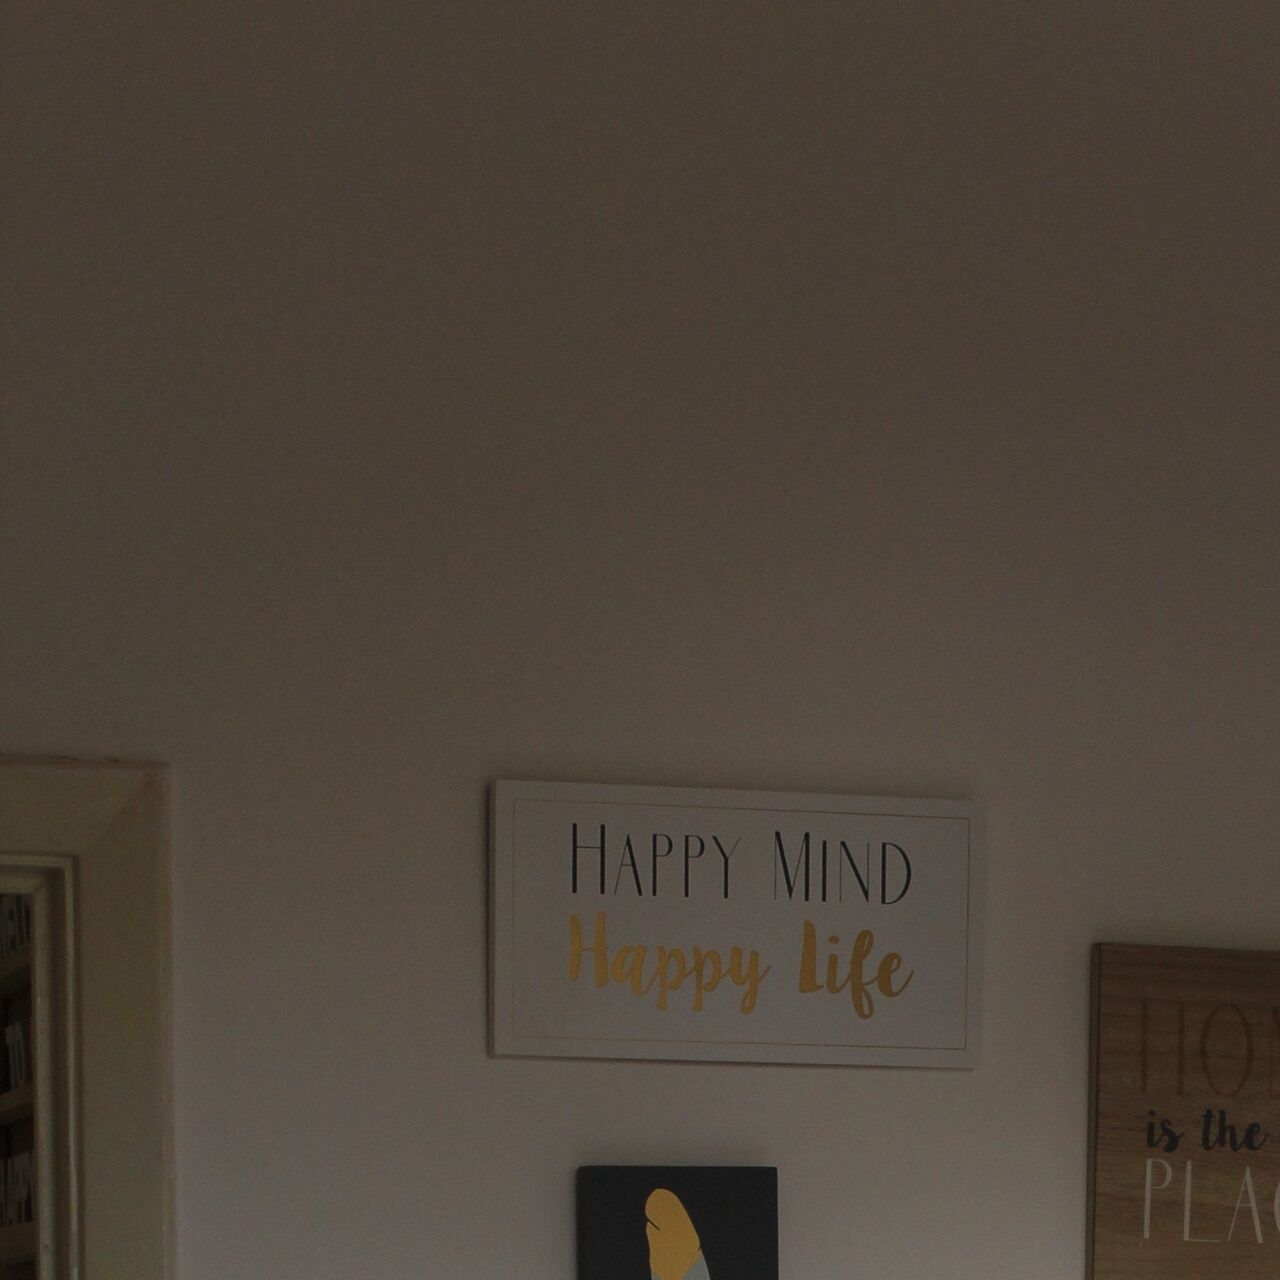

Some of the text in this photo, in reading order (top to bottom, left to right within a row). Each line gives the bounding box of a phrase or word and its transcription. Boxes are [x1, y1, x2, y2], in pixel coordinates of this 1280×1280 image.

[571, 822, 912, 905] HAPPY MIND
[568, 911, 915, 1019] Happy Life
[1147, 1109, 1184, 1153] is
[1202, 1108, 1270, 1152] the
